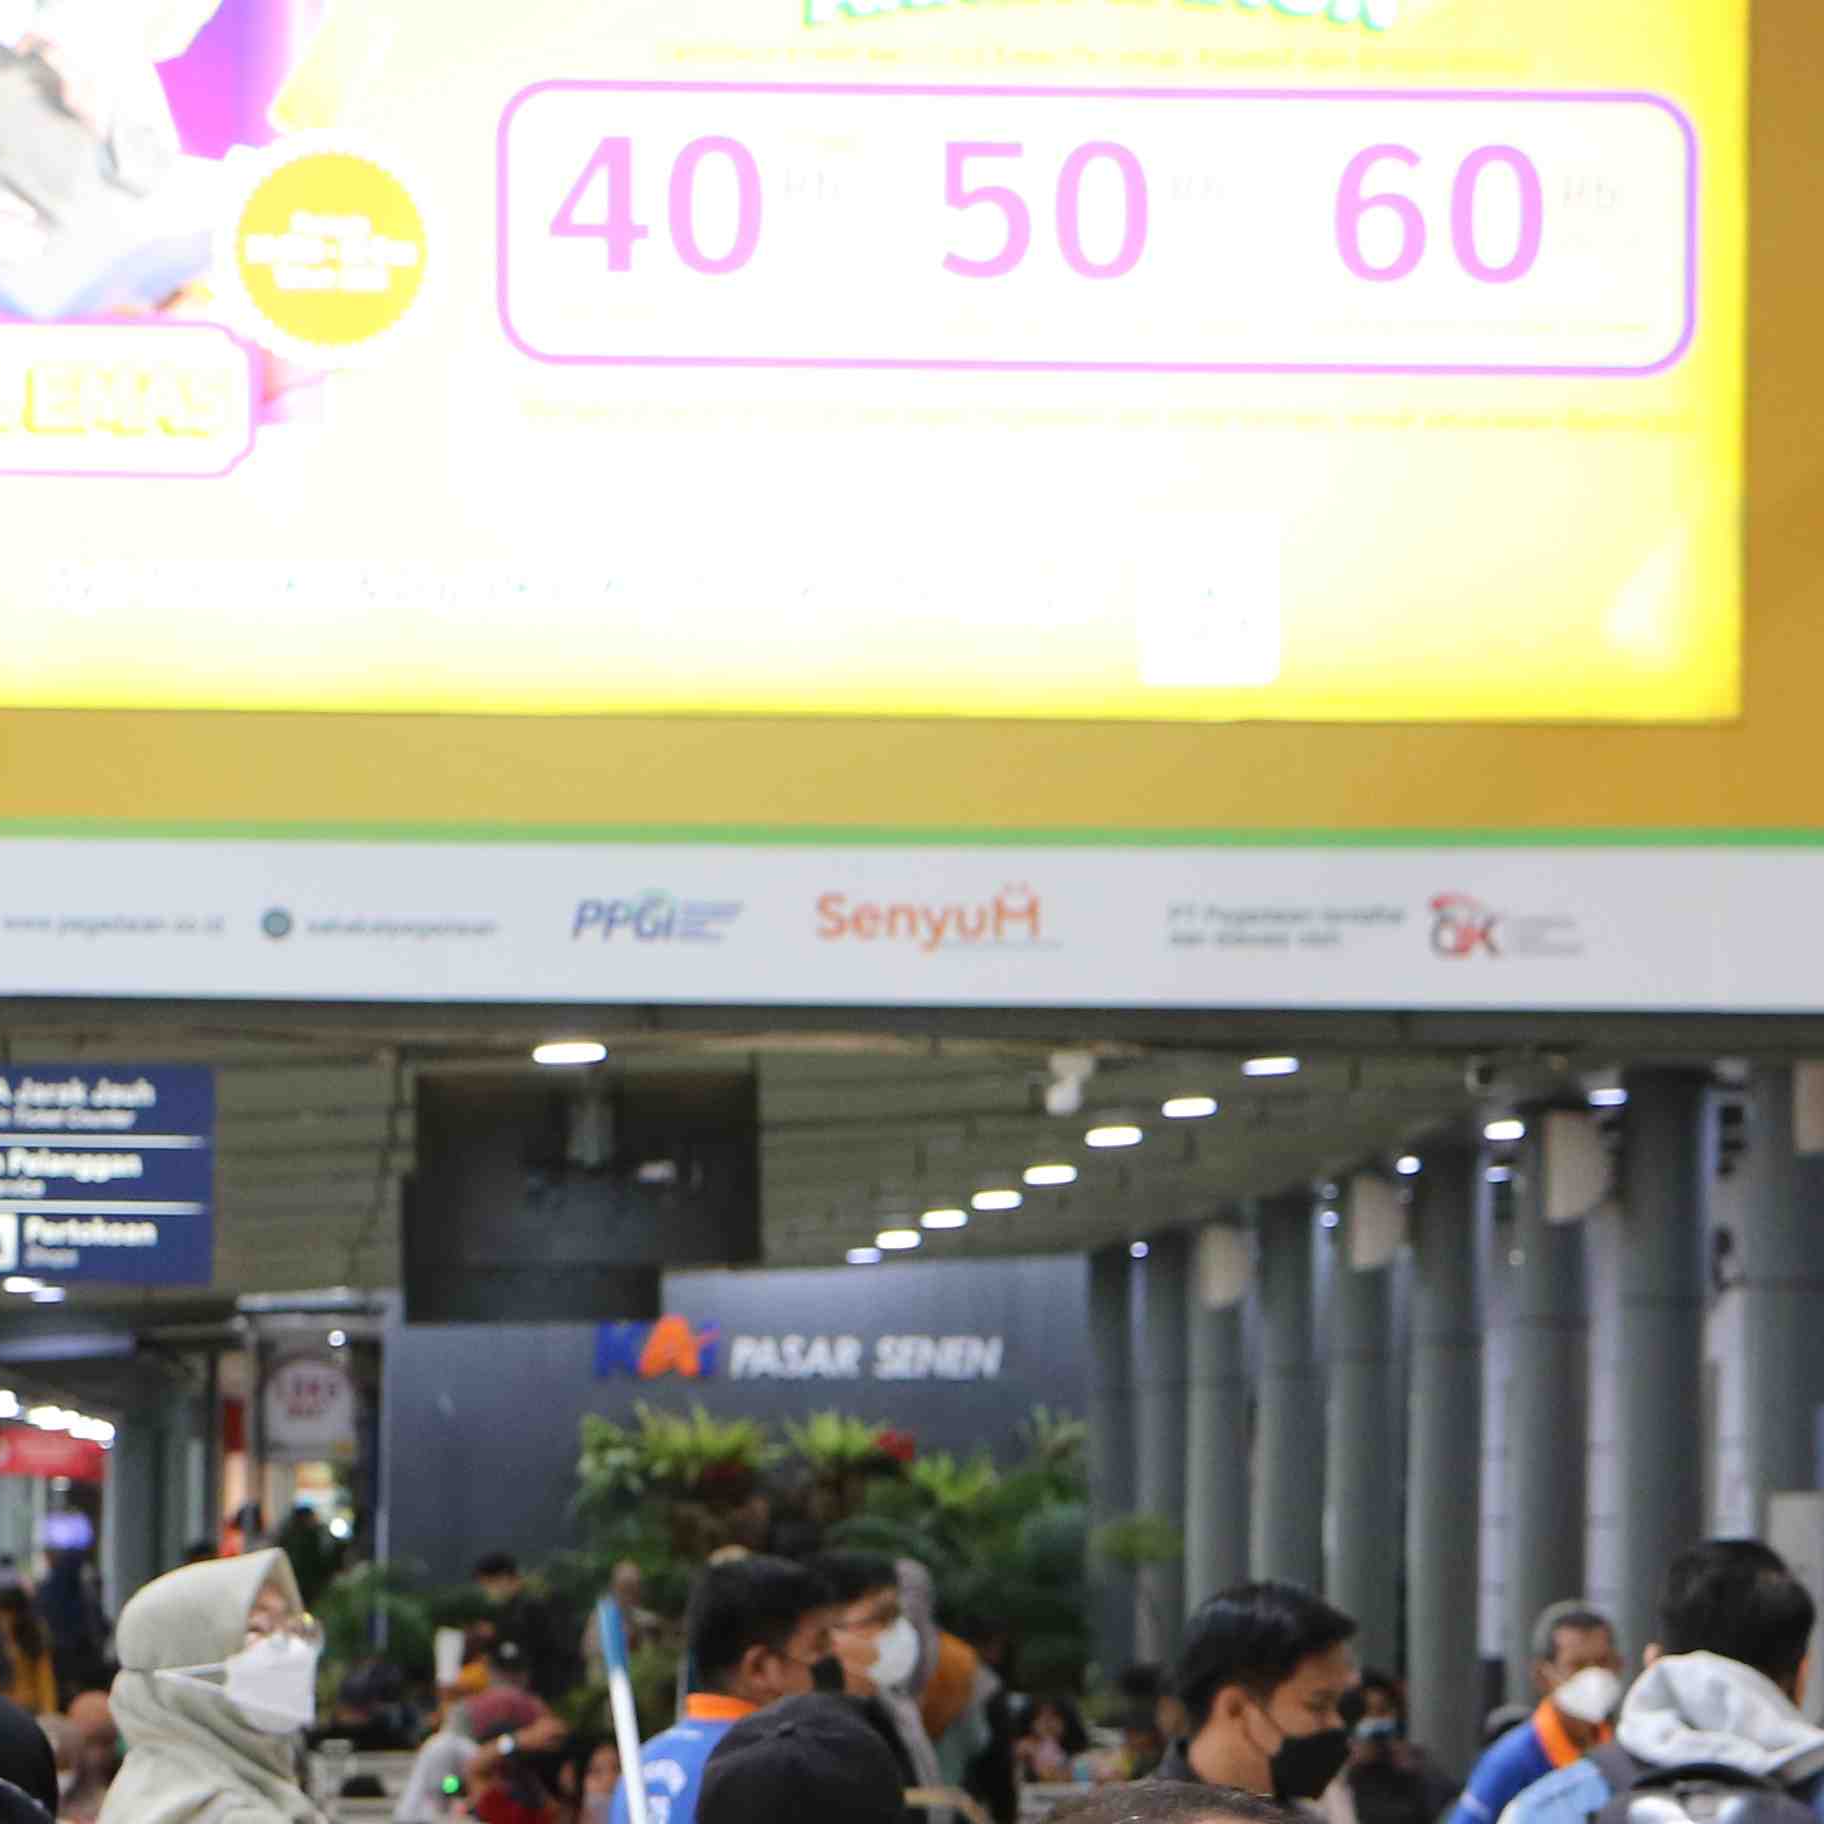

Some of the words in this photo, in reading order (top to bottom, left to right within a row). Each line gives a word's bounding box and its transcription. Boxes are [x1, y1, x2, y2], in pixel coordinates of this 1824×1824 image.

[548, 135, 764, 275] 40
[941, 139, 1149, 279] 50
[1333, 143, 1543, 284] 60
[729, 1334, 865, 1380] PASAR
[875, 1334, 1005, 1380] SENEN
